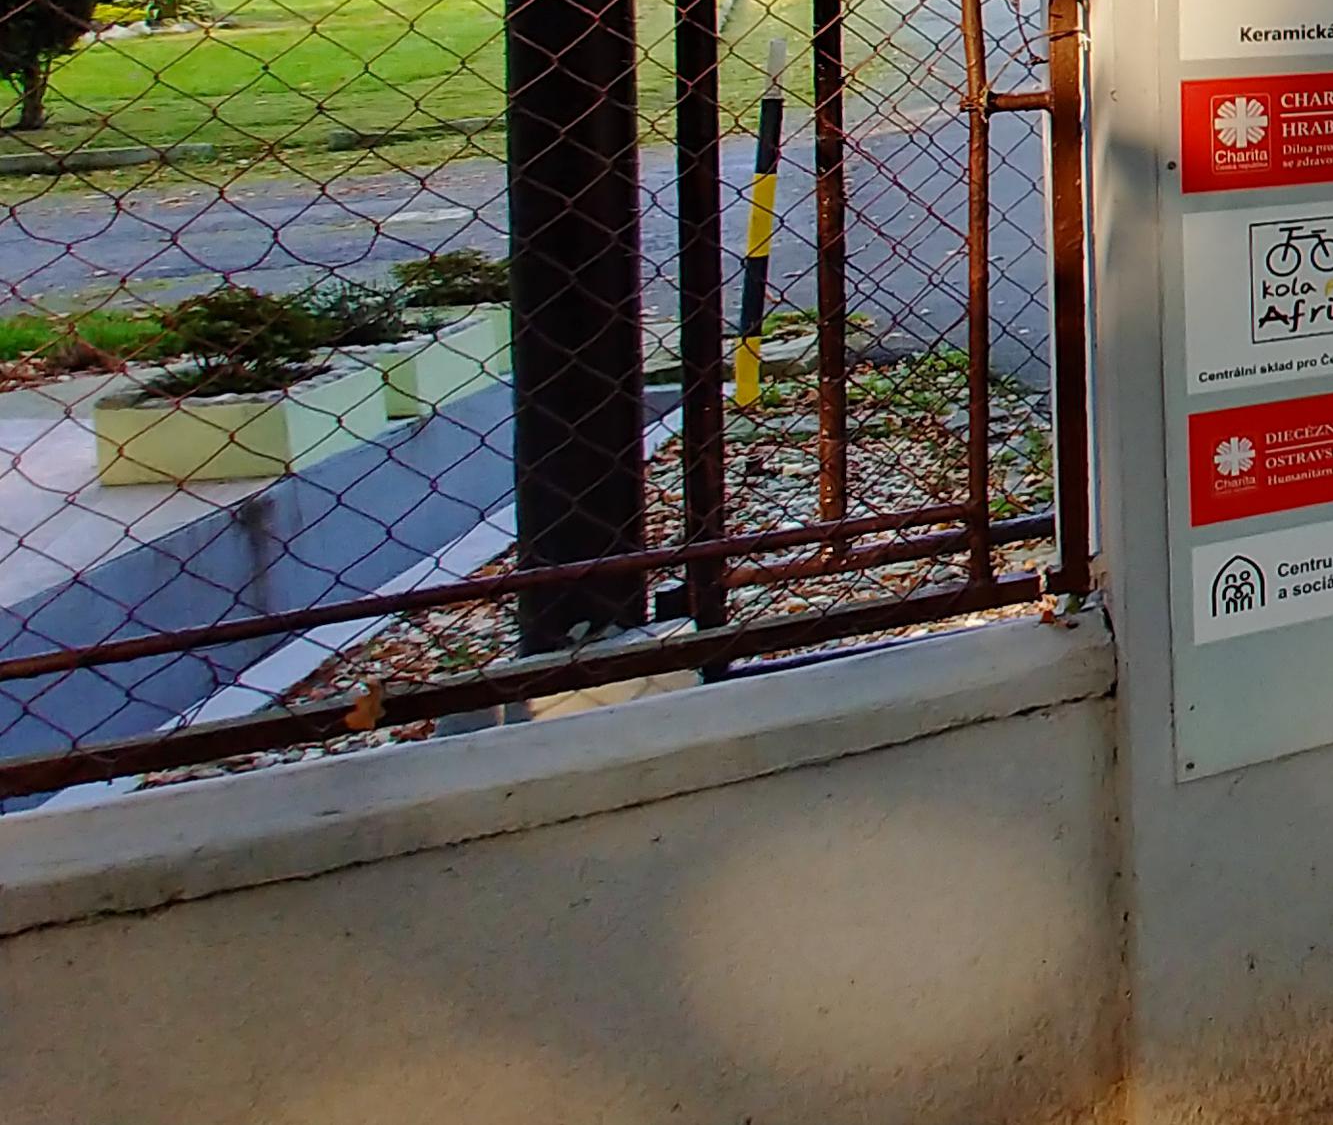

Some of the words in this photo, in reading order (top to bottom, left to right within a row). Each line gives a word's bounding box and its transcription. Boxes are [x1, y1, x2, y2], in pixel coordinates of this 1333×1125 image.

[1214, 148, 1268, 164] Charita
[1282, 142, 1313, 155] Dílna
[1316, 142, 1333, 155] pro
[1262, 278, 1317, 299] kola
[1198, 364, 1257, 383] Centrální
[1260, 359, 1293, 375] sklad
[1296, 357, 1317, 372] pro
[1214, 475, 1256, 491] Charita
[1278, 587, 1288, 599] a
